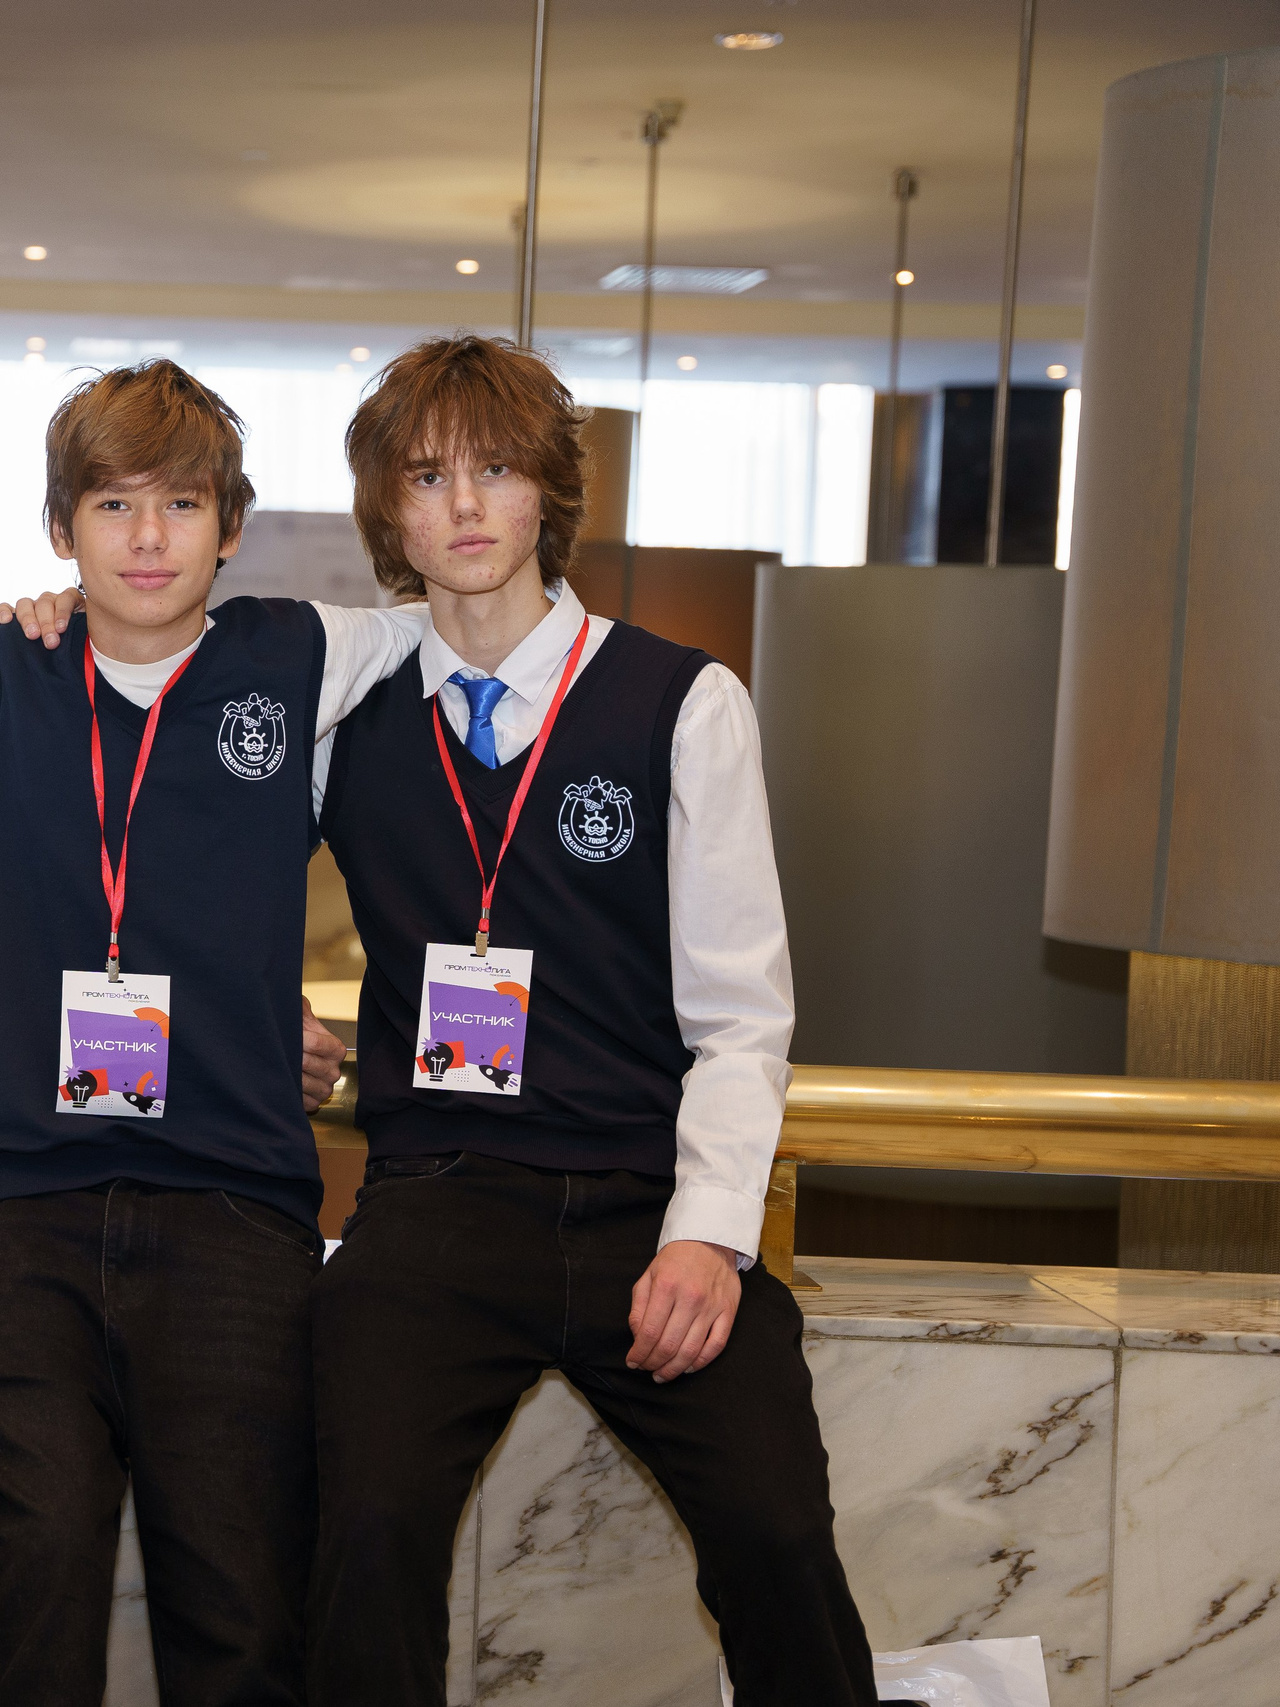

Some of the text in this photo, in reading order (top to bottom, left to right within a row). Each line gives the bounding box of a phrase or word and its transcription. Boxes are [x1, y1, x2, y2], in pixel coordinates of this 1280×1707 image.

[221, 741, 283, 776] ИНЖЕНЕРНАЯ ШКОЛА
[561, 823, 631, 859] ИНЖЕНЕРНАЯ ШКОЛА
[432, 1011, 516, 1028] УЧАСТНИК
[72, 1038, 157, 1054] УЧАСТНИК
